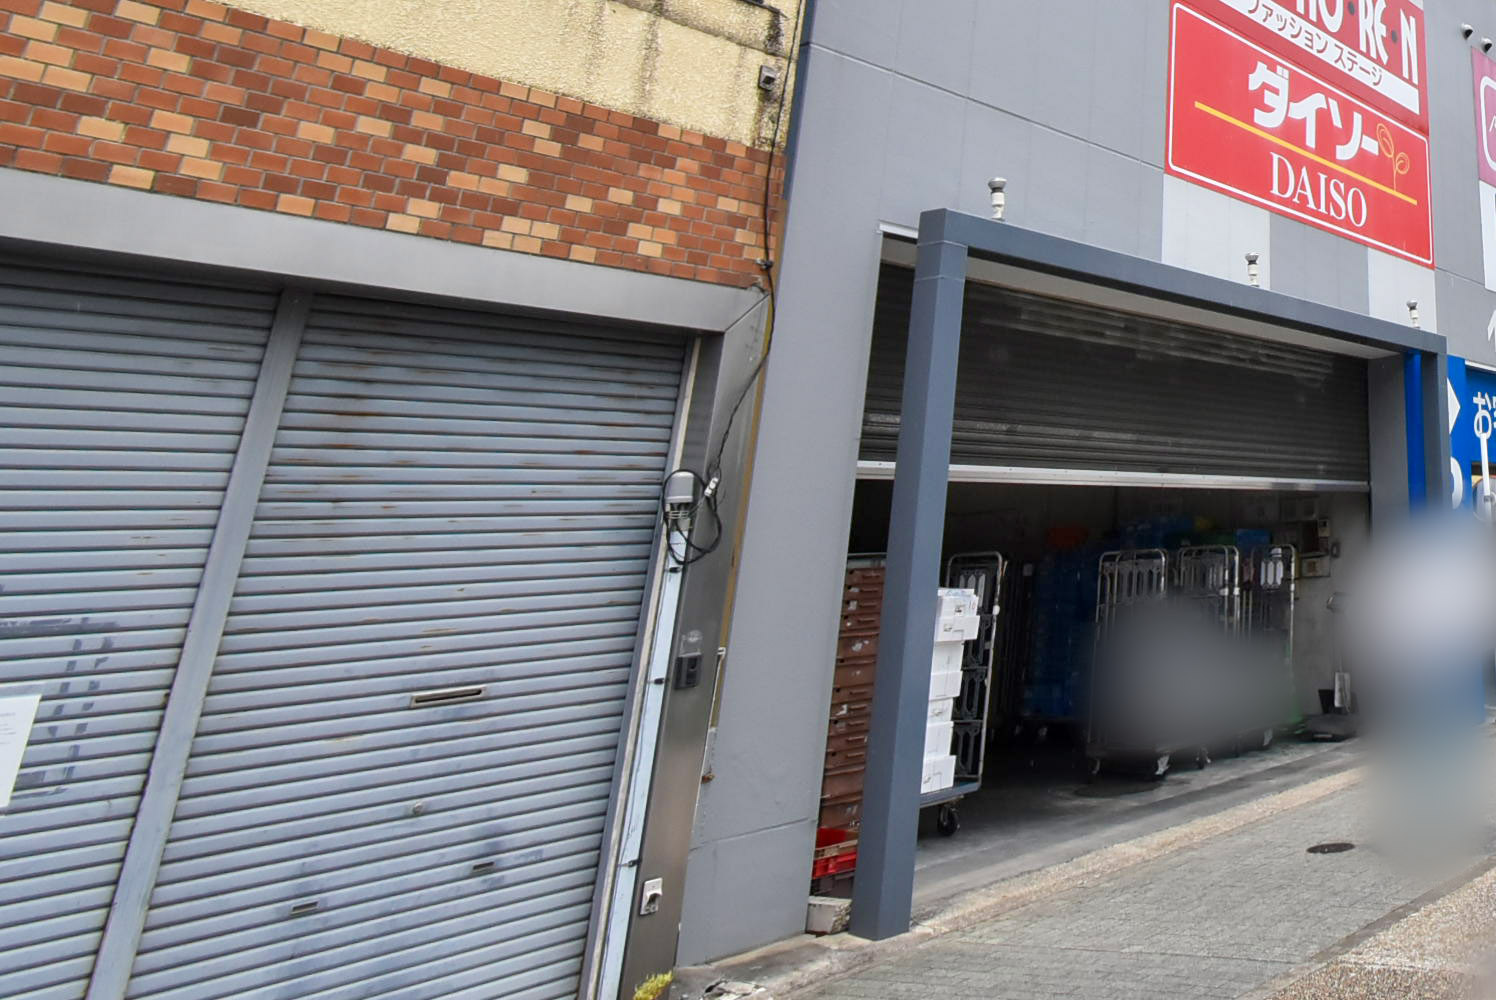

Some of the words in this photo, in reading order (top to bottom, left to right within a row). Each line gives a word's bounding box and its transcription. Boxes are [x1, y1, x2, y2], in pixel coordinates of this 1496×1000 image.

[1334, 43, 1383, 86] ステージ
[1247, 59, 1380, 161] ダイソー
[1269, 151, 1368, 228] DAISO
